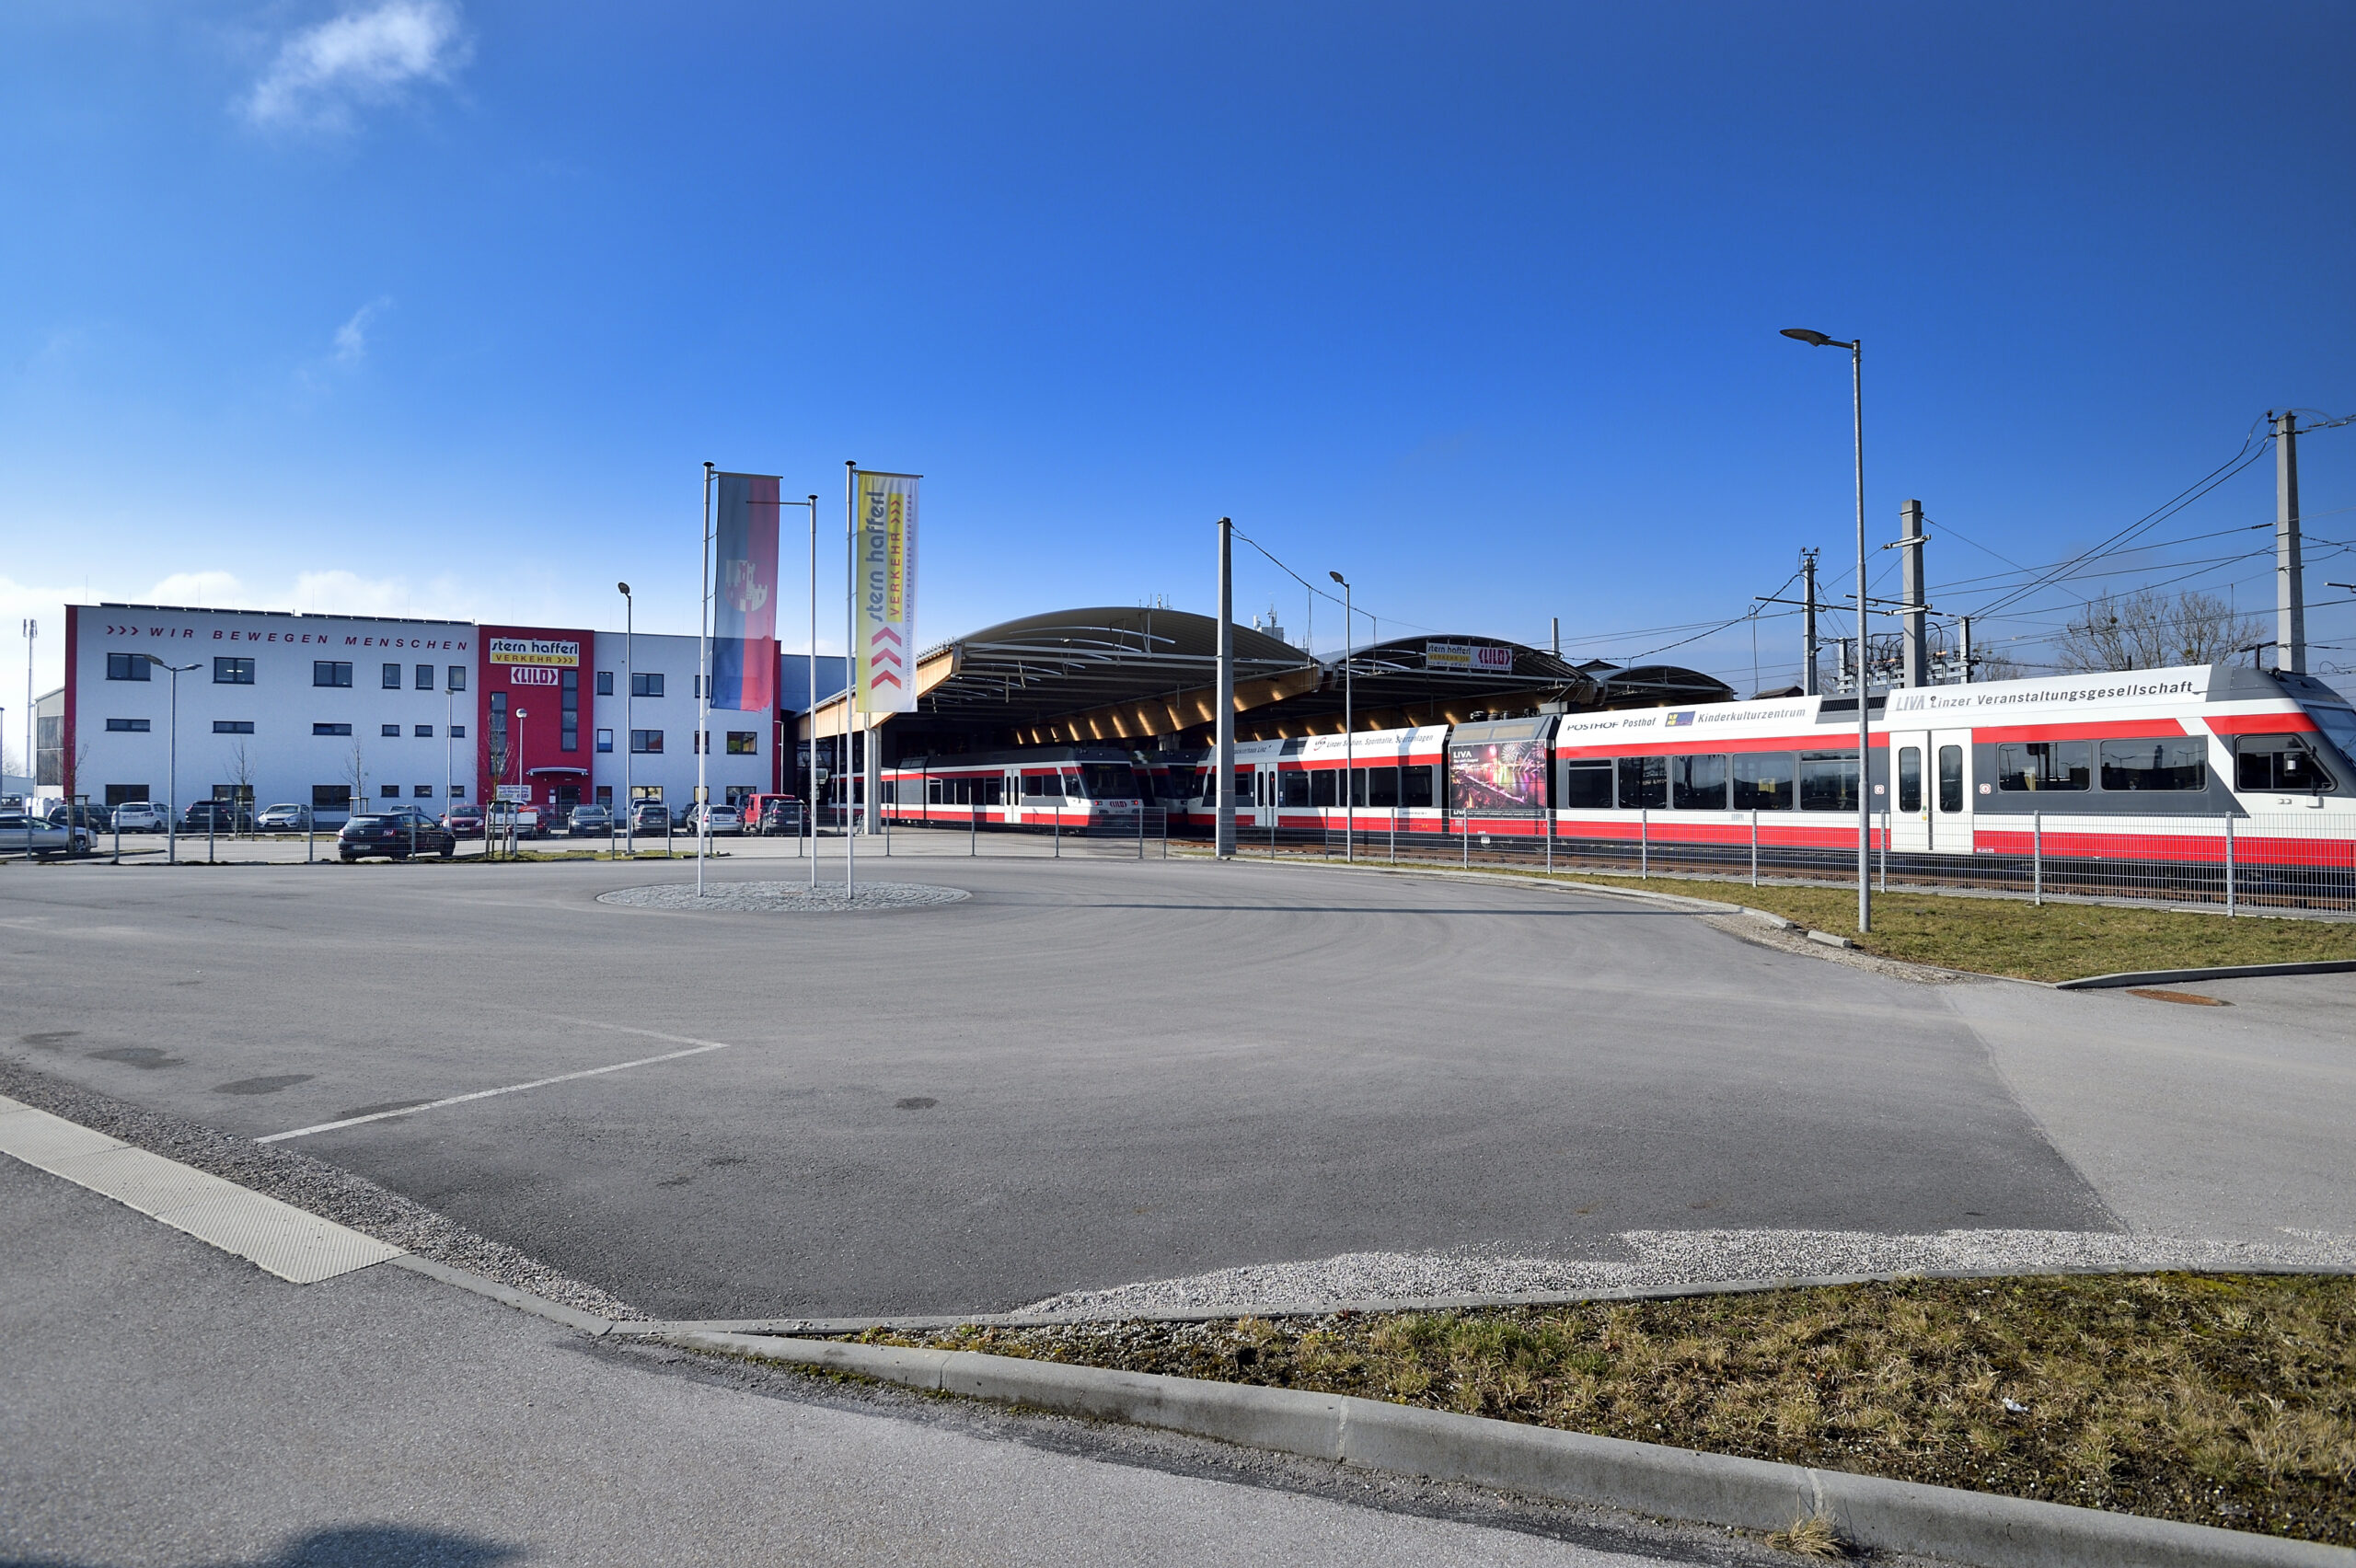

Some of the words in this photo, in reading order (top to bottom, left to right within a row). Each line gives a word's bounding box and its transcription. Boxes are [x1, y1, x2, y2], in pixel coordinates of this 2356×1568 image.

[865, 491, 884, 562] hafferl
[890, 533, 901, 617] VERKEHR
[865, 571, 884, 623] stern
[150, 627, 194, 639] WIR
[213, 630, 329, 644] BEWEGEN
[345, 636, 468, 651] MENSCHEN
[491, 640, 526, 652] stern
[531, 641, 578, 654] hafferl
[1427, 644, 1446, 652] stern
[1448, 645, 1471, 655] hafferl
[496, 654, 552, 663] VERKEHR
[1484, 649, 1505, 665] LILO
[521, 669, 549, 684] LILO
[1896, 695, 1925, 711] LIVA
[1930, 697, 1972, 709] Linzer
[1978, 681, 2193, 705] Veranstaltungsgesellschaft
[1697, 708, 1806, 723] Kinderkulturzentrum
[1567, 721, 1619, 731] POSTHOF
[1622, 717, 1657, 728] Posthof
[1453, 750, 1472, 759] LIVA
